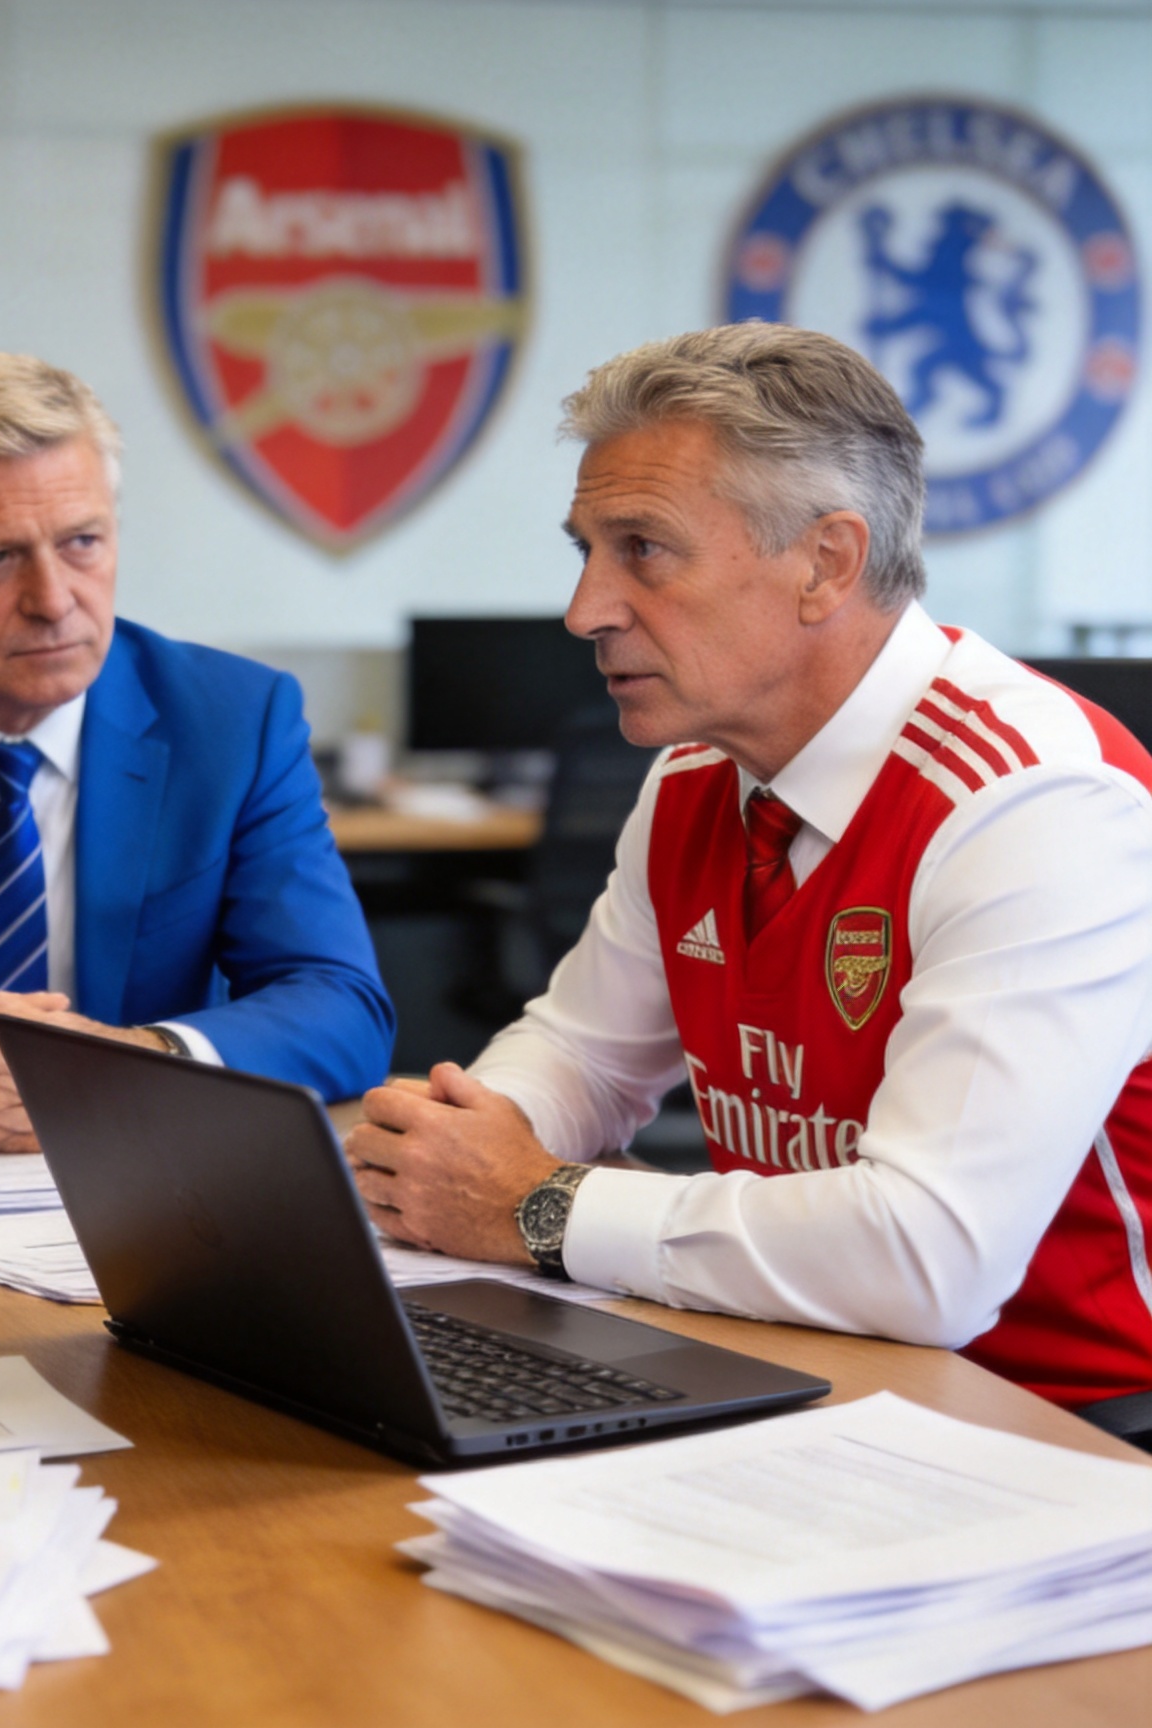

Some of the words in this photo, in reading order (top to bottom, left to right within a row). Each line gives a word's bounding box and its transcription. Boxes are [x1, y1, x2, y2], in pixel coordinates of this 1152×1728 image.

[790, 108, 1078, 210] CHELSEA
[206, 174, 475, 259] Arsenal
[736, 1022, 804, 1100] Fly
[684, 1050, 864, 1173] Emirate
